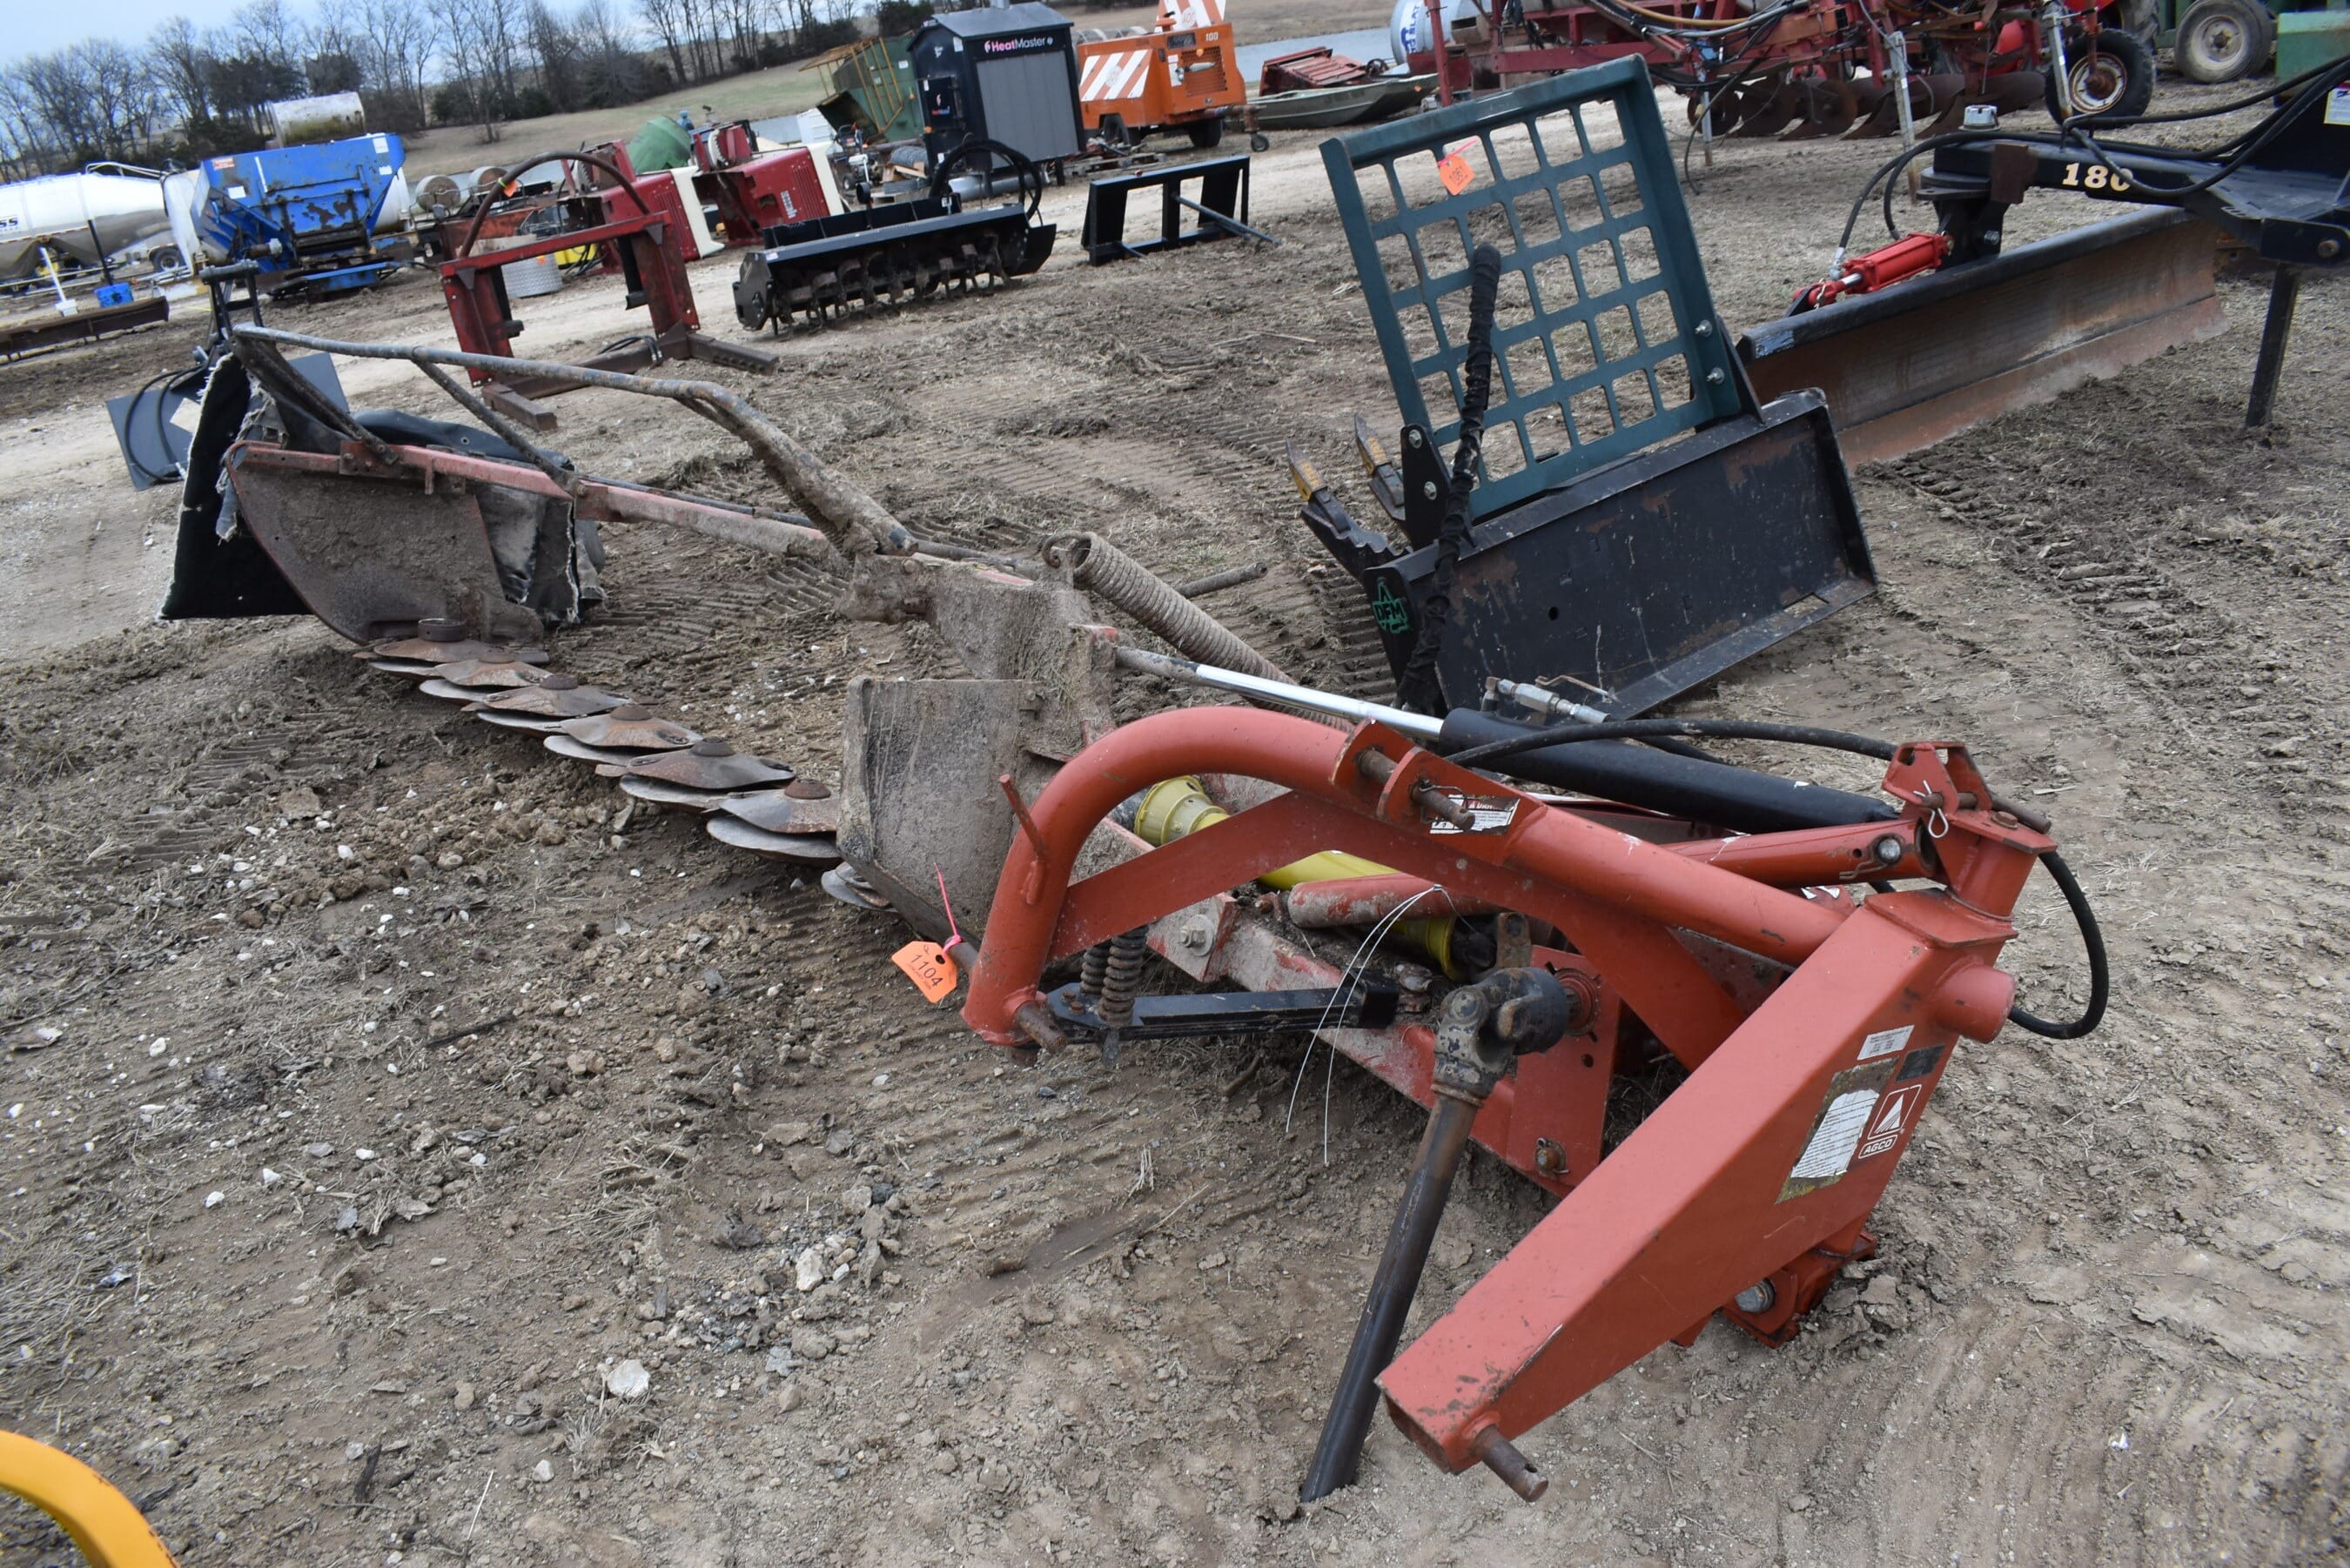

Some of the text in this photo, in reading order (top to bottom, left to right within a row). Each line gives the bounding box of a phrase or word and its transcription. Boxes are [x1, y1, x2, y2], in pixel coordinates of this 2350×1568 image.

[991, 37, 1046, 52] HeatMaster
[1205, 32, 1219, 42] 100
[2062, 162, 2134, 192] 180
[911, 954, 943, 988] 1104
[1863, 1139, 1893, 1155] AGCO
